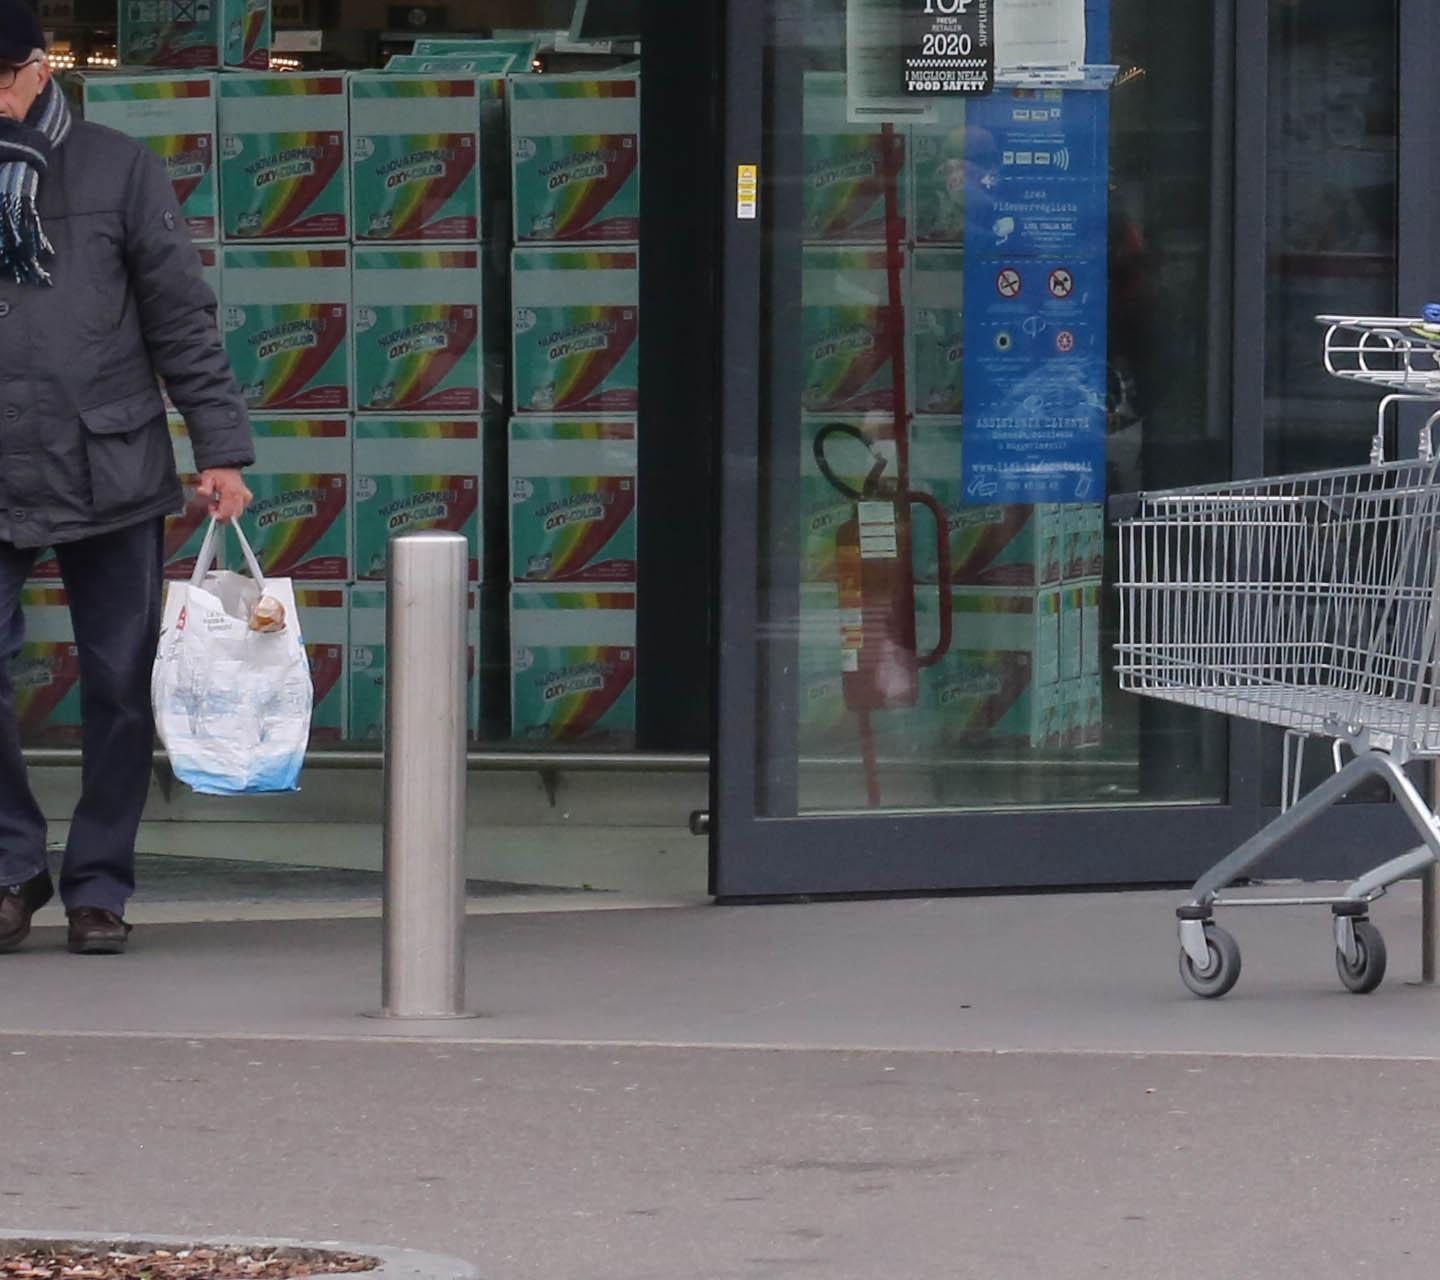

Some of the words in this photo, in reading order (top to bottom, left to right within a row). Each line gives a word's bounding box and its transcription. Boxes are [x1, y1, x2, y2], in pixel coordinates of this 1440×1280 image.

[922, 34, 971, 55] 2020
[905, 71, 909, 81] I
[911, 71, 957, 81] MIGLIORI
[959, 71, 988, 81] NELLA
[908, 81, 941, 91] FOOD
[943, 81, 985, 91] SAFETY
